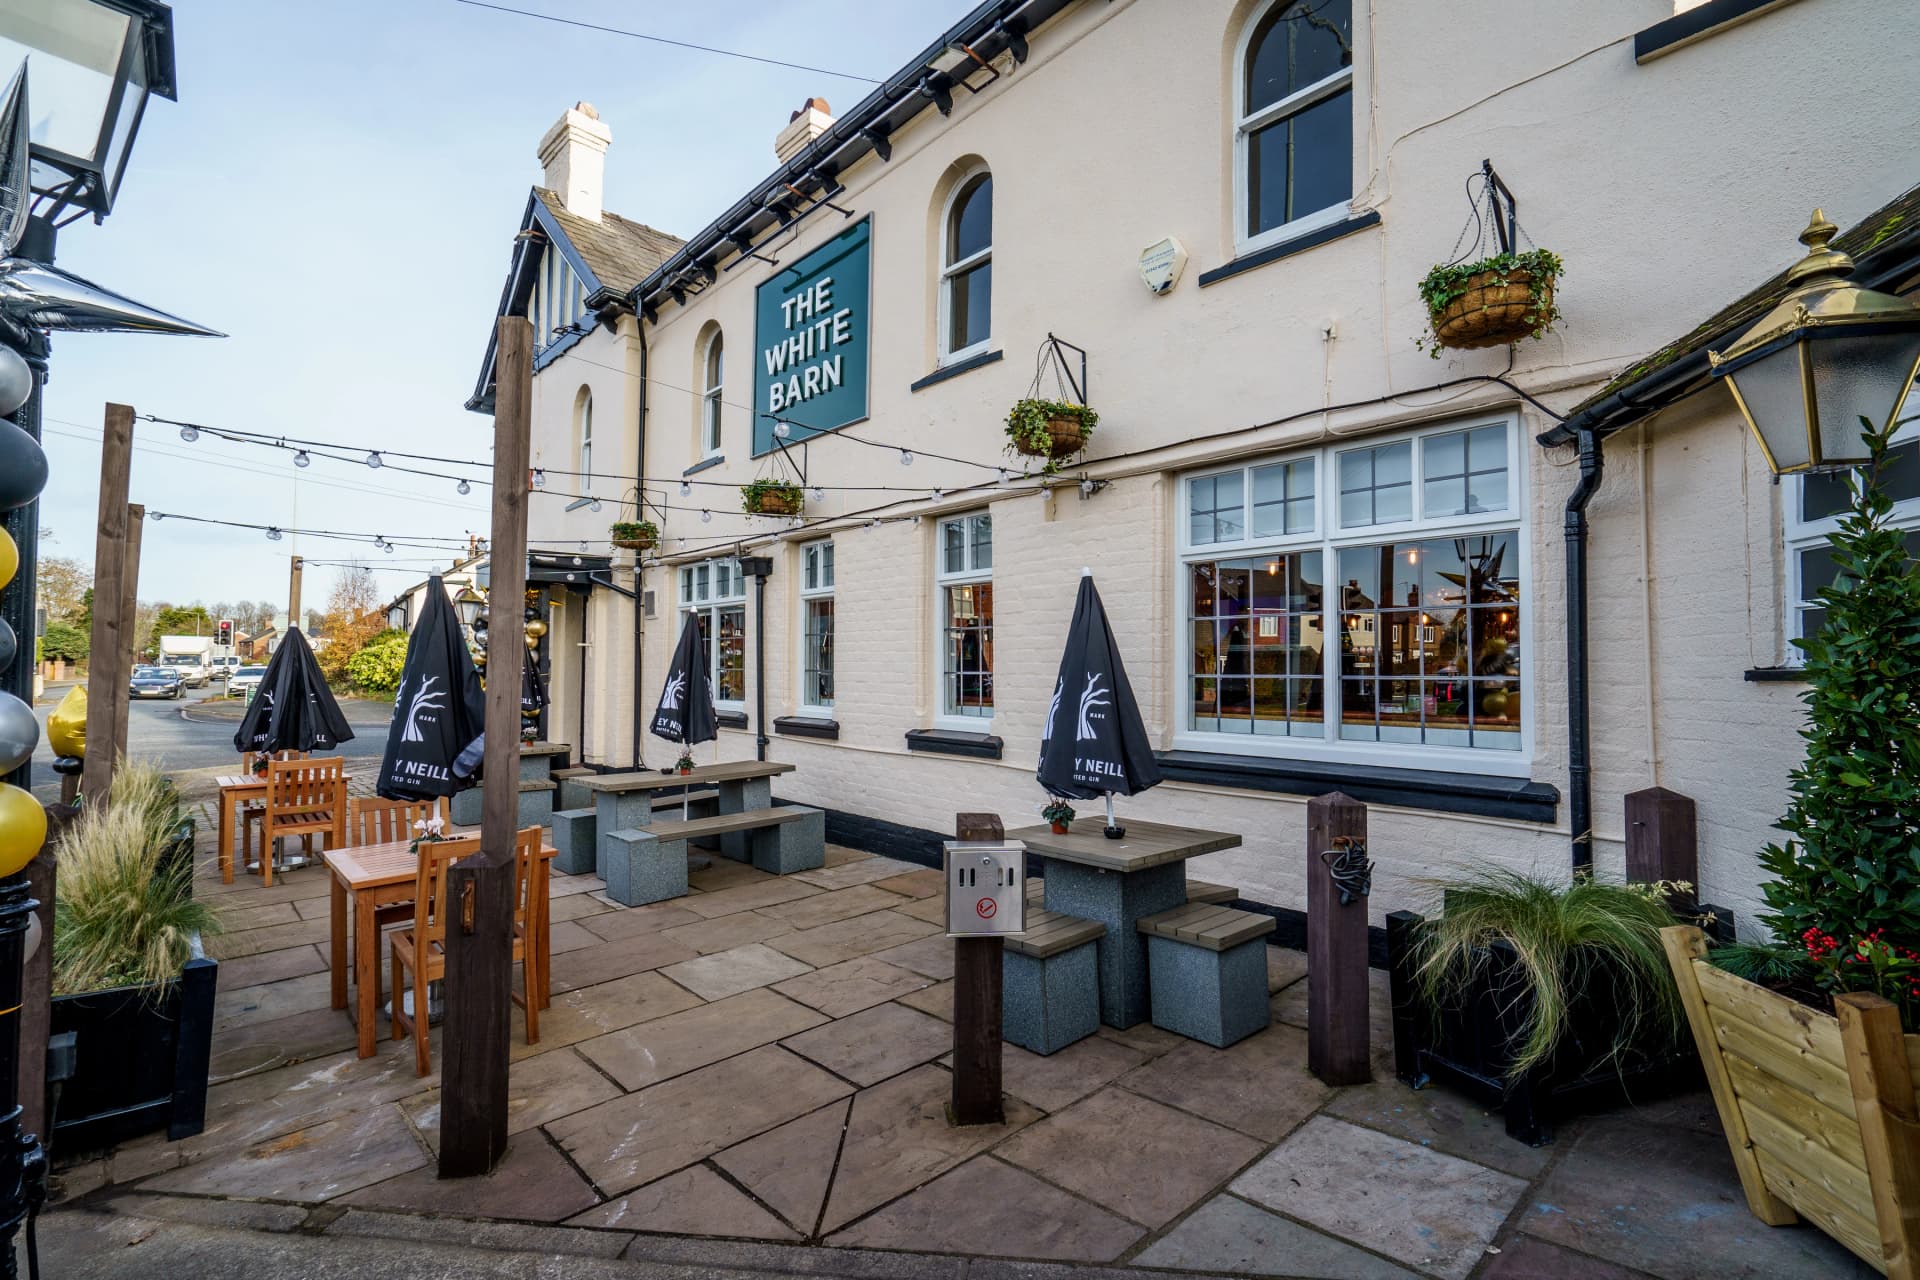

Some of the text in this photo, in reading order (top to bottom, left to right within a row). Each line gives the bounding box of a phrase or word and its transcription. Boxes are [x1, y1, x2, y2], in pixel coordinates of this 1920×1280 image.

[781, 276, 834, 330] THE
[764, 307, 850, 376] WHITE
[769, 354, 842, 413] BARN
[405, 760, 449, 780] NEILL
[1085, 759, 1124, 778] NEILL
